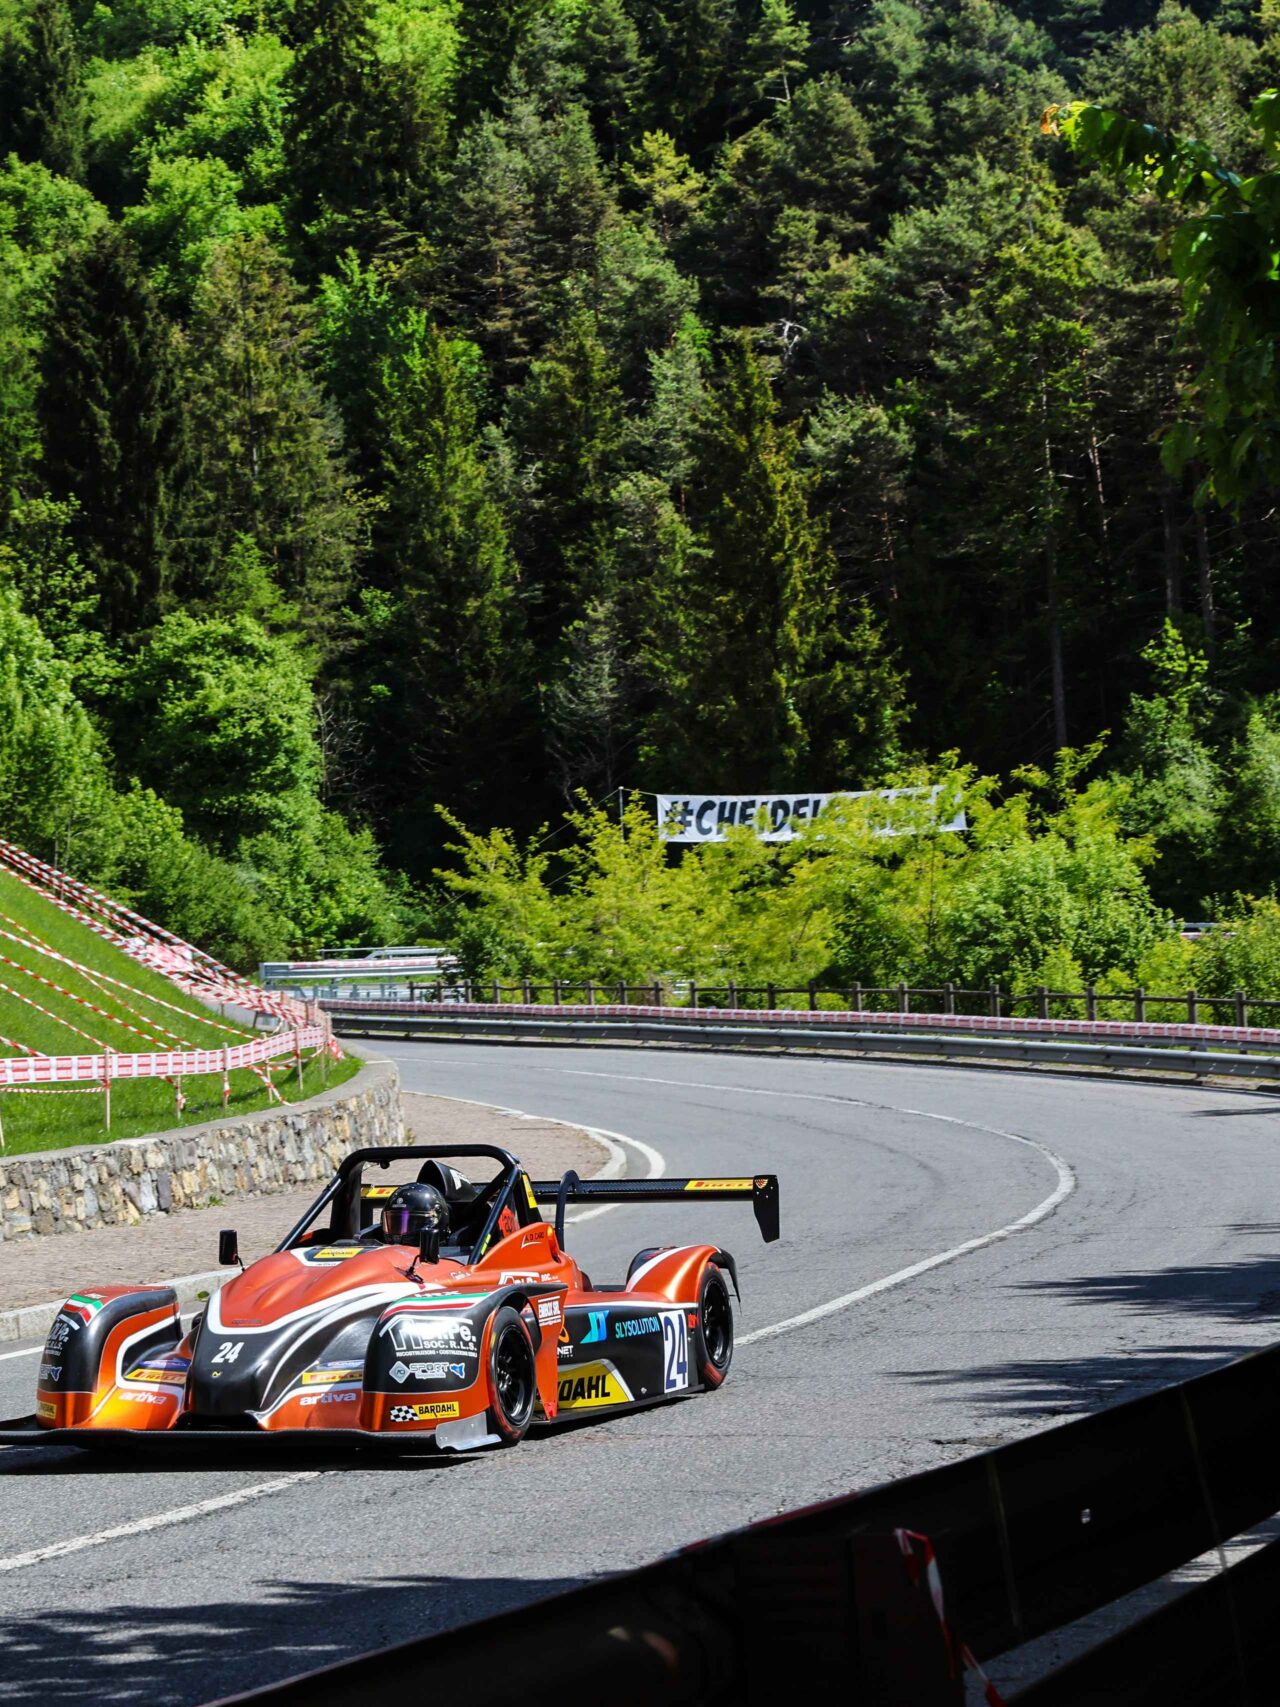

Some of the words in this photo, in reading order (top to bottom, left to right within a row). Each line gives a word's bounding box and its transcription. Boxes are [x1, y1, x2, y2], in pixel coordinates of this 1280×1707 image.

[615, 1316, 661, 1339] SLYSOLUTION
[211, 1341, 245, 1363] 24
[423, 1340, 449, 1349] SOC.
[663, 1313, 688, 1390] 24
[299, 1391, 357, 1406] artiva
[557, 1374, 611, 1401] DAHL
[418, 1403, 456, 1417] BARDAHL
